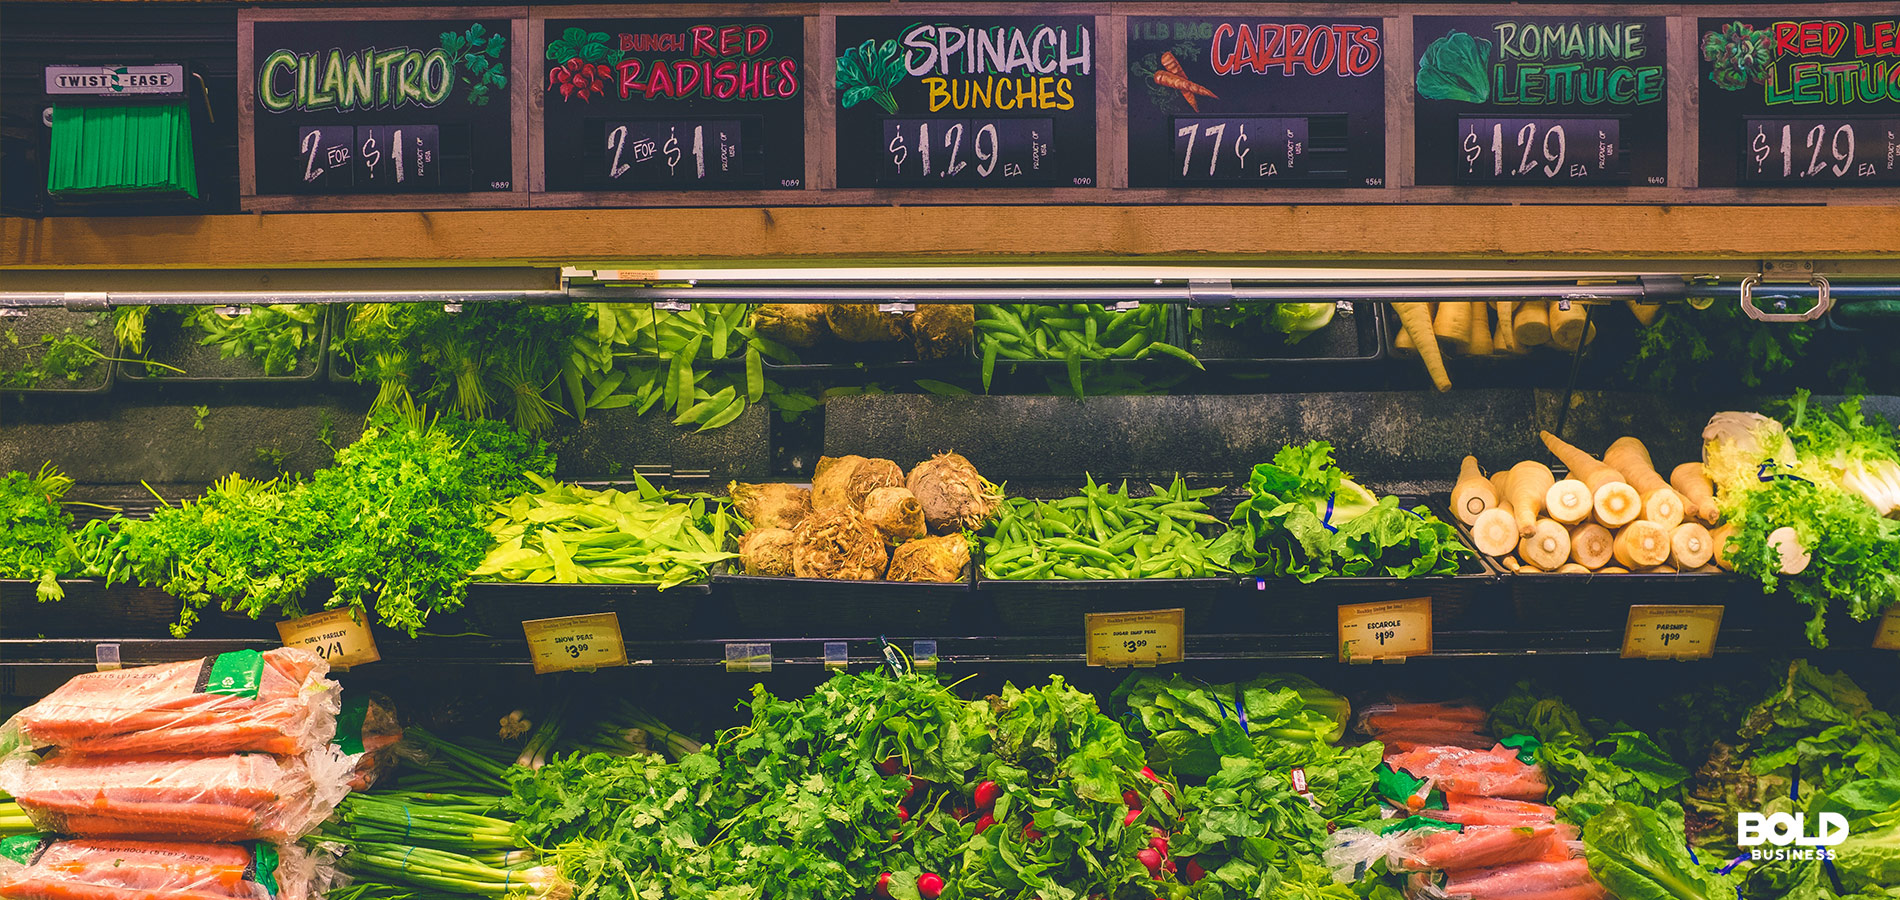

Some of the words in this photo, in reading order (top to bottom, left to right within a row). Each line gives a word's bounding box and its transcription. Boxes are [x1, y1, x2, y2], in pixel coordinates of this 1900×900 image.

[619, 33, 685, 51] BUNCH
[689, 25, 772, 57] RED
[1144, 22, 1169, 41] LB
[1173, 21, 1213, 41] BAG
[1493, 21, 1646, 61] ROMAINE
[1772, 20, 1849, 57] RED
[904, 24, 1090, 76] SPINACH
[1211, 23, 1382, 76] CARROTS
[59, 76, 108, 87] TWIST
[259, 46, 456, 112] CILANTRO
[616, 58, 799, 100] RADISHES
[921, 76, 1074, 112] BUNCHES
[1493, 63, 1665, 105] LETTUCE
[416, 137, 424, 146] OF
[720, 132, 727, 141] OF
[1032, 130, 1039, 139] OF
[1287, 129, 1294, 138] OF
[1599, 130, 1606, 139] OF
[1887, 131, 1895, 139] OF
[301, 129, 324, 182] 2
[327, 146, 351, 166] FOR
[416, 149, 424, 177] PRODUCT
[607, 125, 630, 178] 2
[633, 141, 657, 160] FOR
[889, 123, 998, 177] $1.29
[1004, 163, 1022, 177] EA
[1463, 123, 1565, 177] $1.29
[1570, 164, 1587, 177] EA
[1752, 124, 1855, 178] $1.29
[1858, 162, 1876, 177] EA
[1259, 162, 1278, 177] EA
[305, 635, 321, 645] CURLY
[323, 630, 347, 640] PARSLEY
[576, 633, 593, 641] PEAS
[1367, 620, 1401, 630] ESCAROLE
[316, 641, 344, 660] 2/$1
